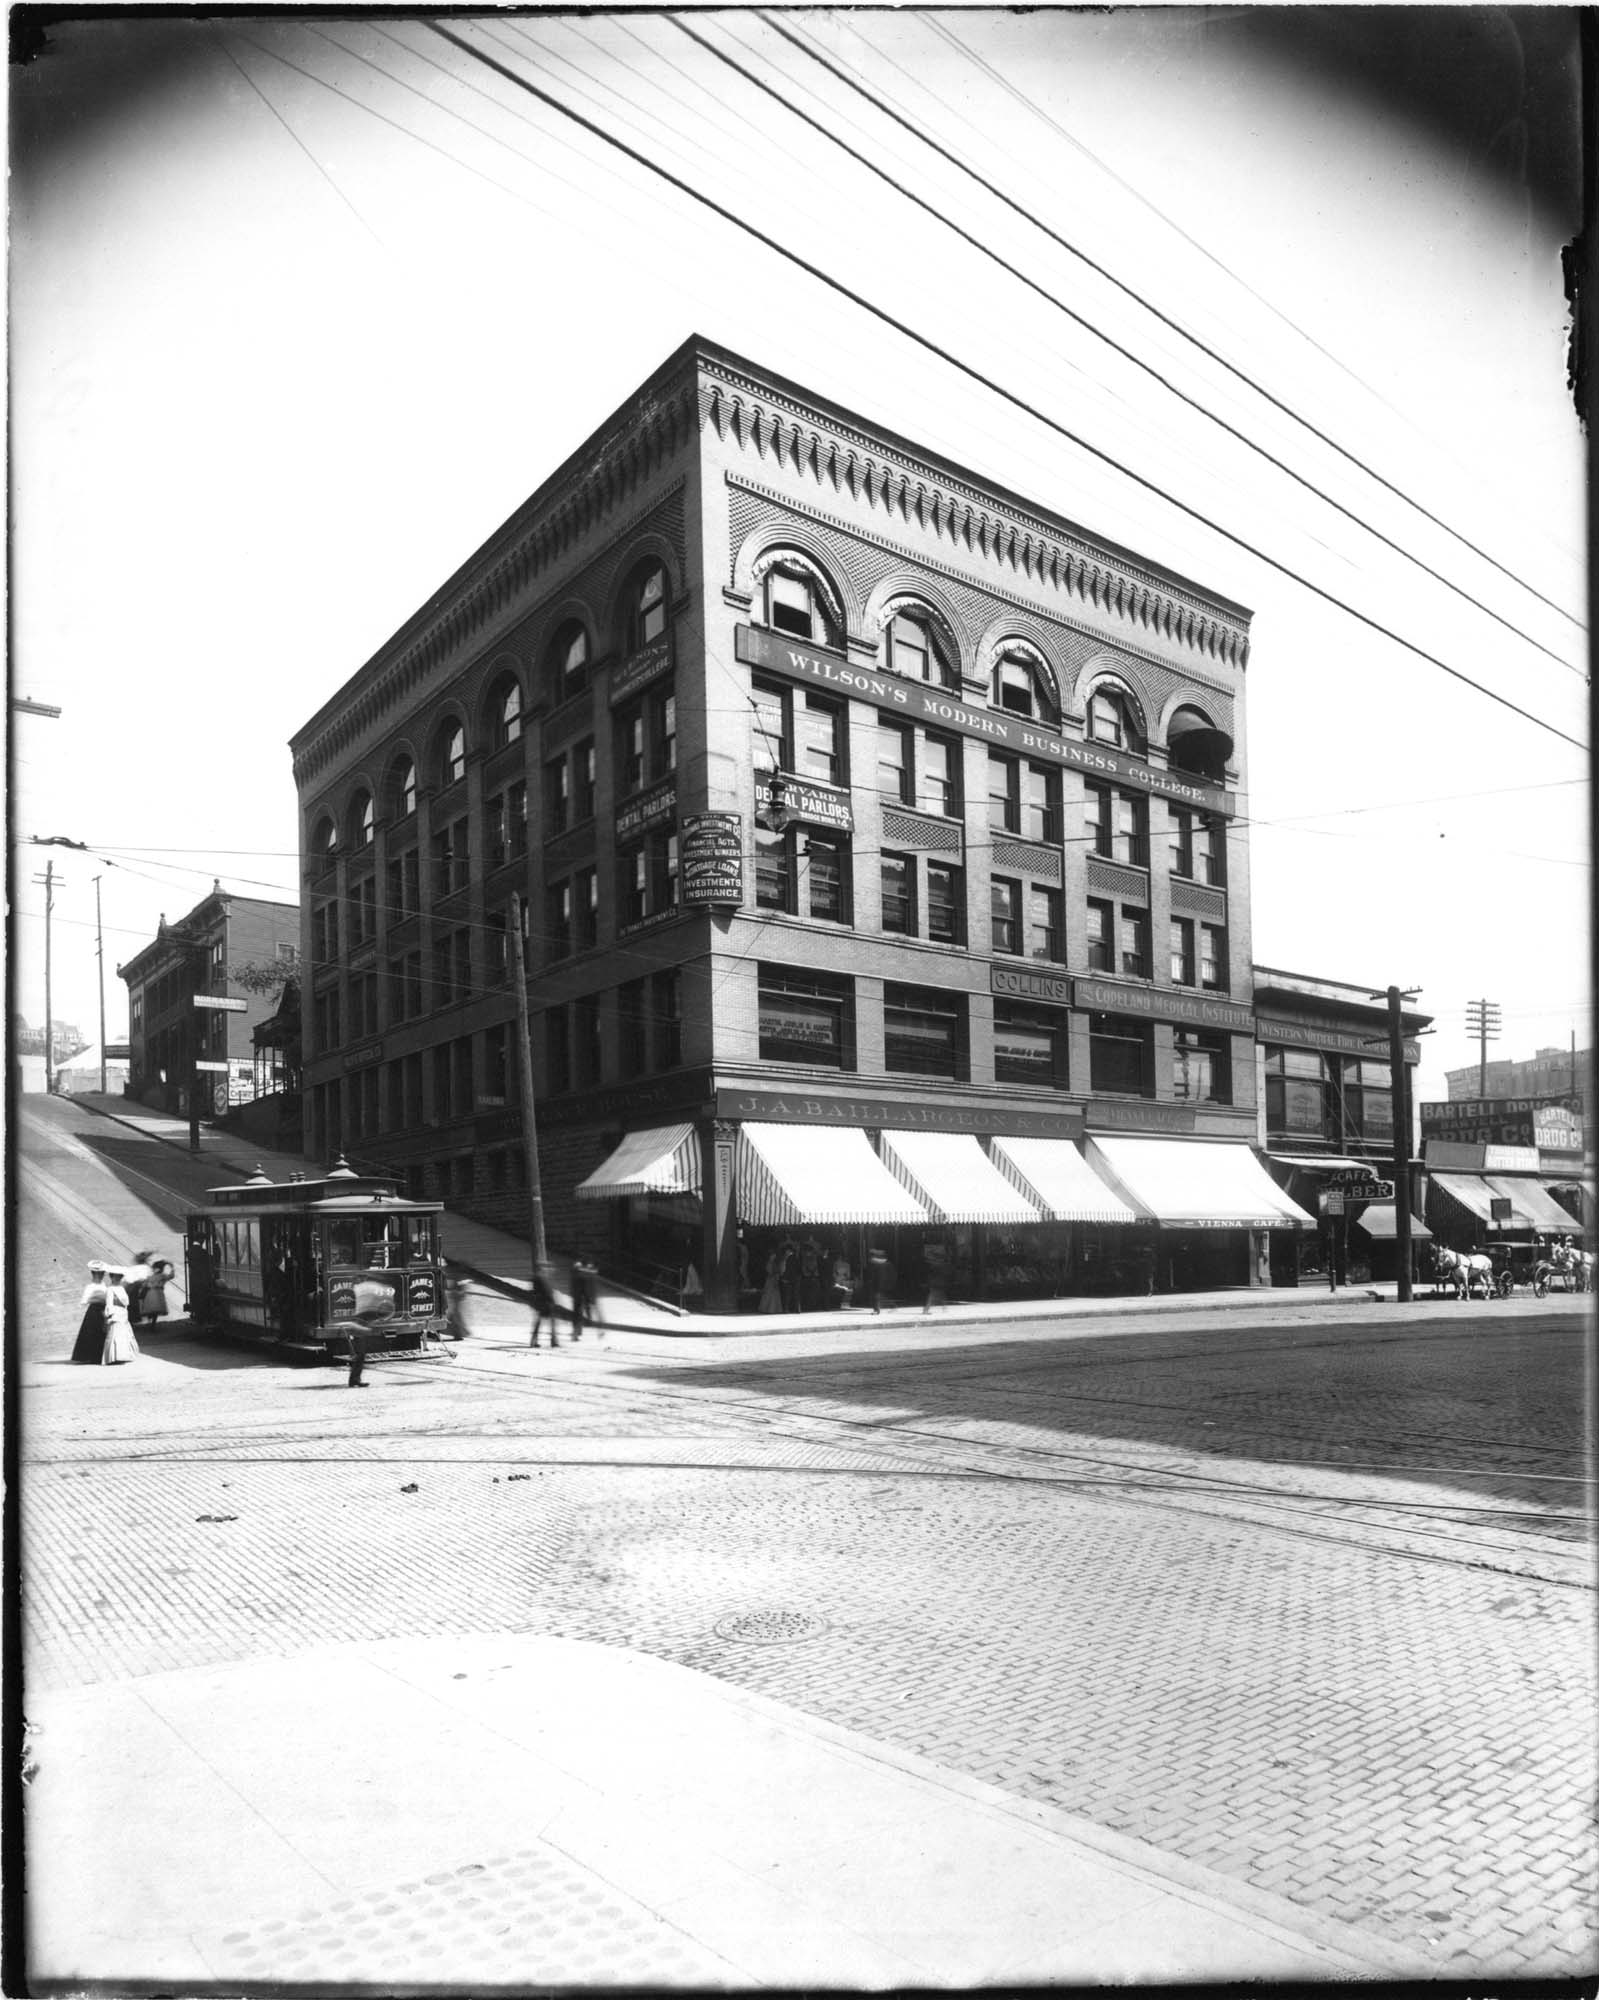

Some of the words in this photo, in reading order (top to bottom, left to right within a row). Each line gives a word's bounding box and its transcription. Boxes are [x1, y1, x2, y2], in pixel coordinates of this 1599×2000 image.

[787, 650, 908, 703] WILSON'S
[924, 698, 1009, 739] MODERN
[1022, 732, 1118, 773] BUSINESS
[1128, 767, 1206, 801] COLLEGE.
[995, 972, 1066, 998] COLLINS
[1095, 986, 1151, 1011] COPELAND
[1154, 994, 1198, 1018] MEDICAL
[1202, 1003, 1253, 1026] INSTITUTE
[1261, 1023, 1301, 1040] WESTERN
[1423, 1102, 1495, 1120] BARTELL
[1541, 1108, 1576, 1127] BARTELL
[1534, 1127, 1567, 1147] DRUG
[1336, 1170, 1370, 1183] CAFE
[1198, 1220, 1243, 1228] VIENNA
[409, 1278, 433, 1289] JAMES
[411, 1303, 433, 1312] STREET
